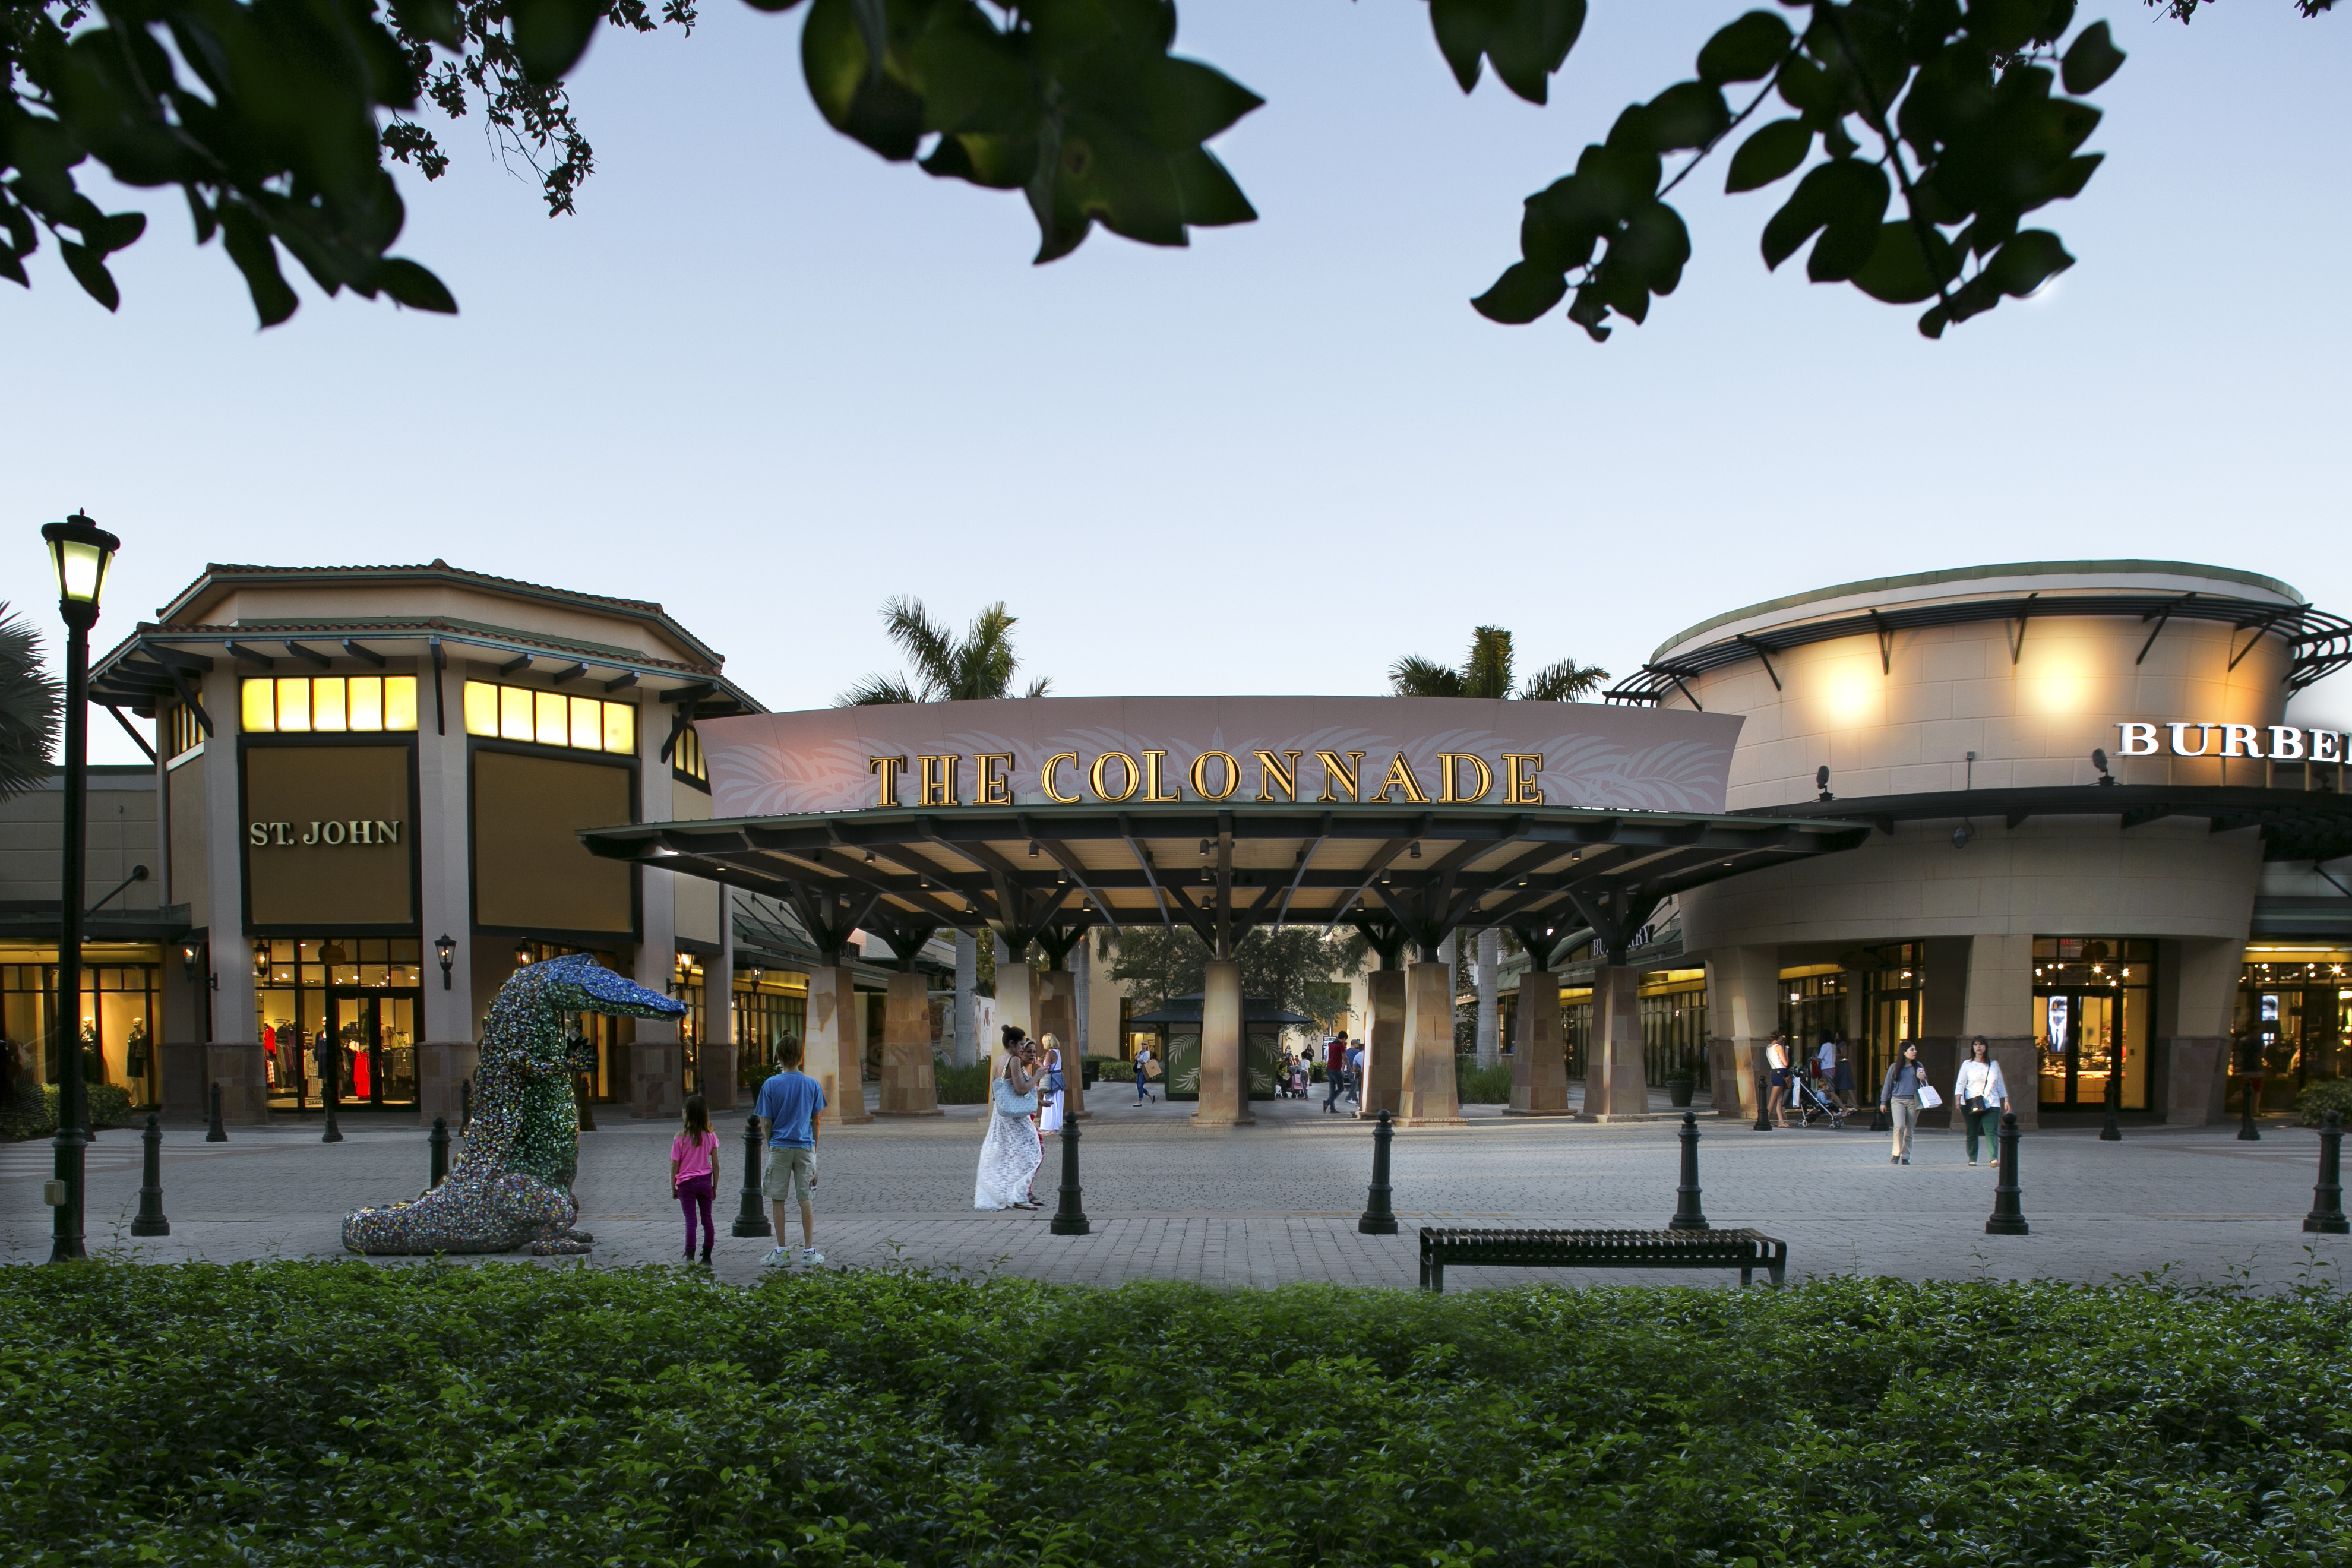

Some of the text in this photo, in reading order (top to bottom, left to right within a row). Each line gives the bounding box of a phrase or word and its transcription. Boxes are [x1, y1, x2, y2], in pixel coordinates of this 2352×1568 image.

[869, 749, 1544, 807] THE COLONNADE
[250, 820, 400, 846] ST. JOHN
[1592, 925, 1650, 956] BURY
